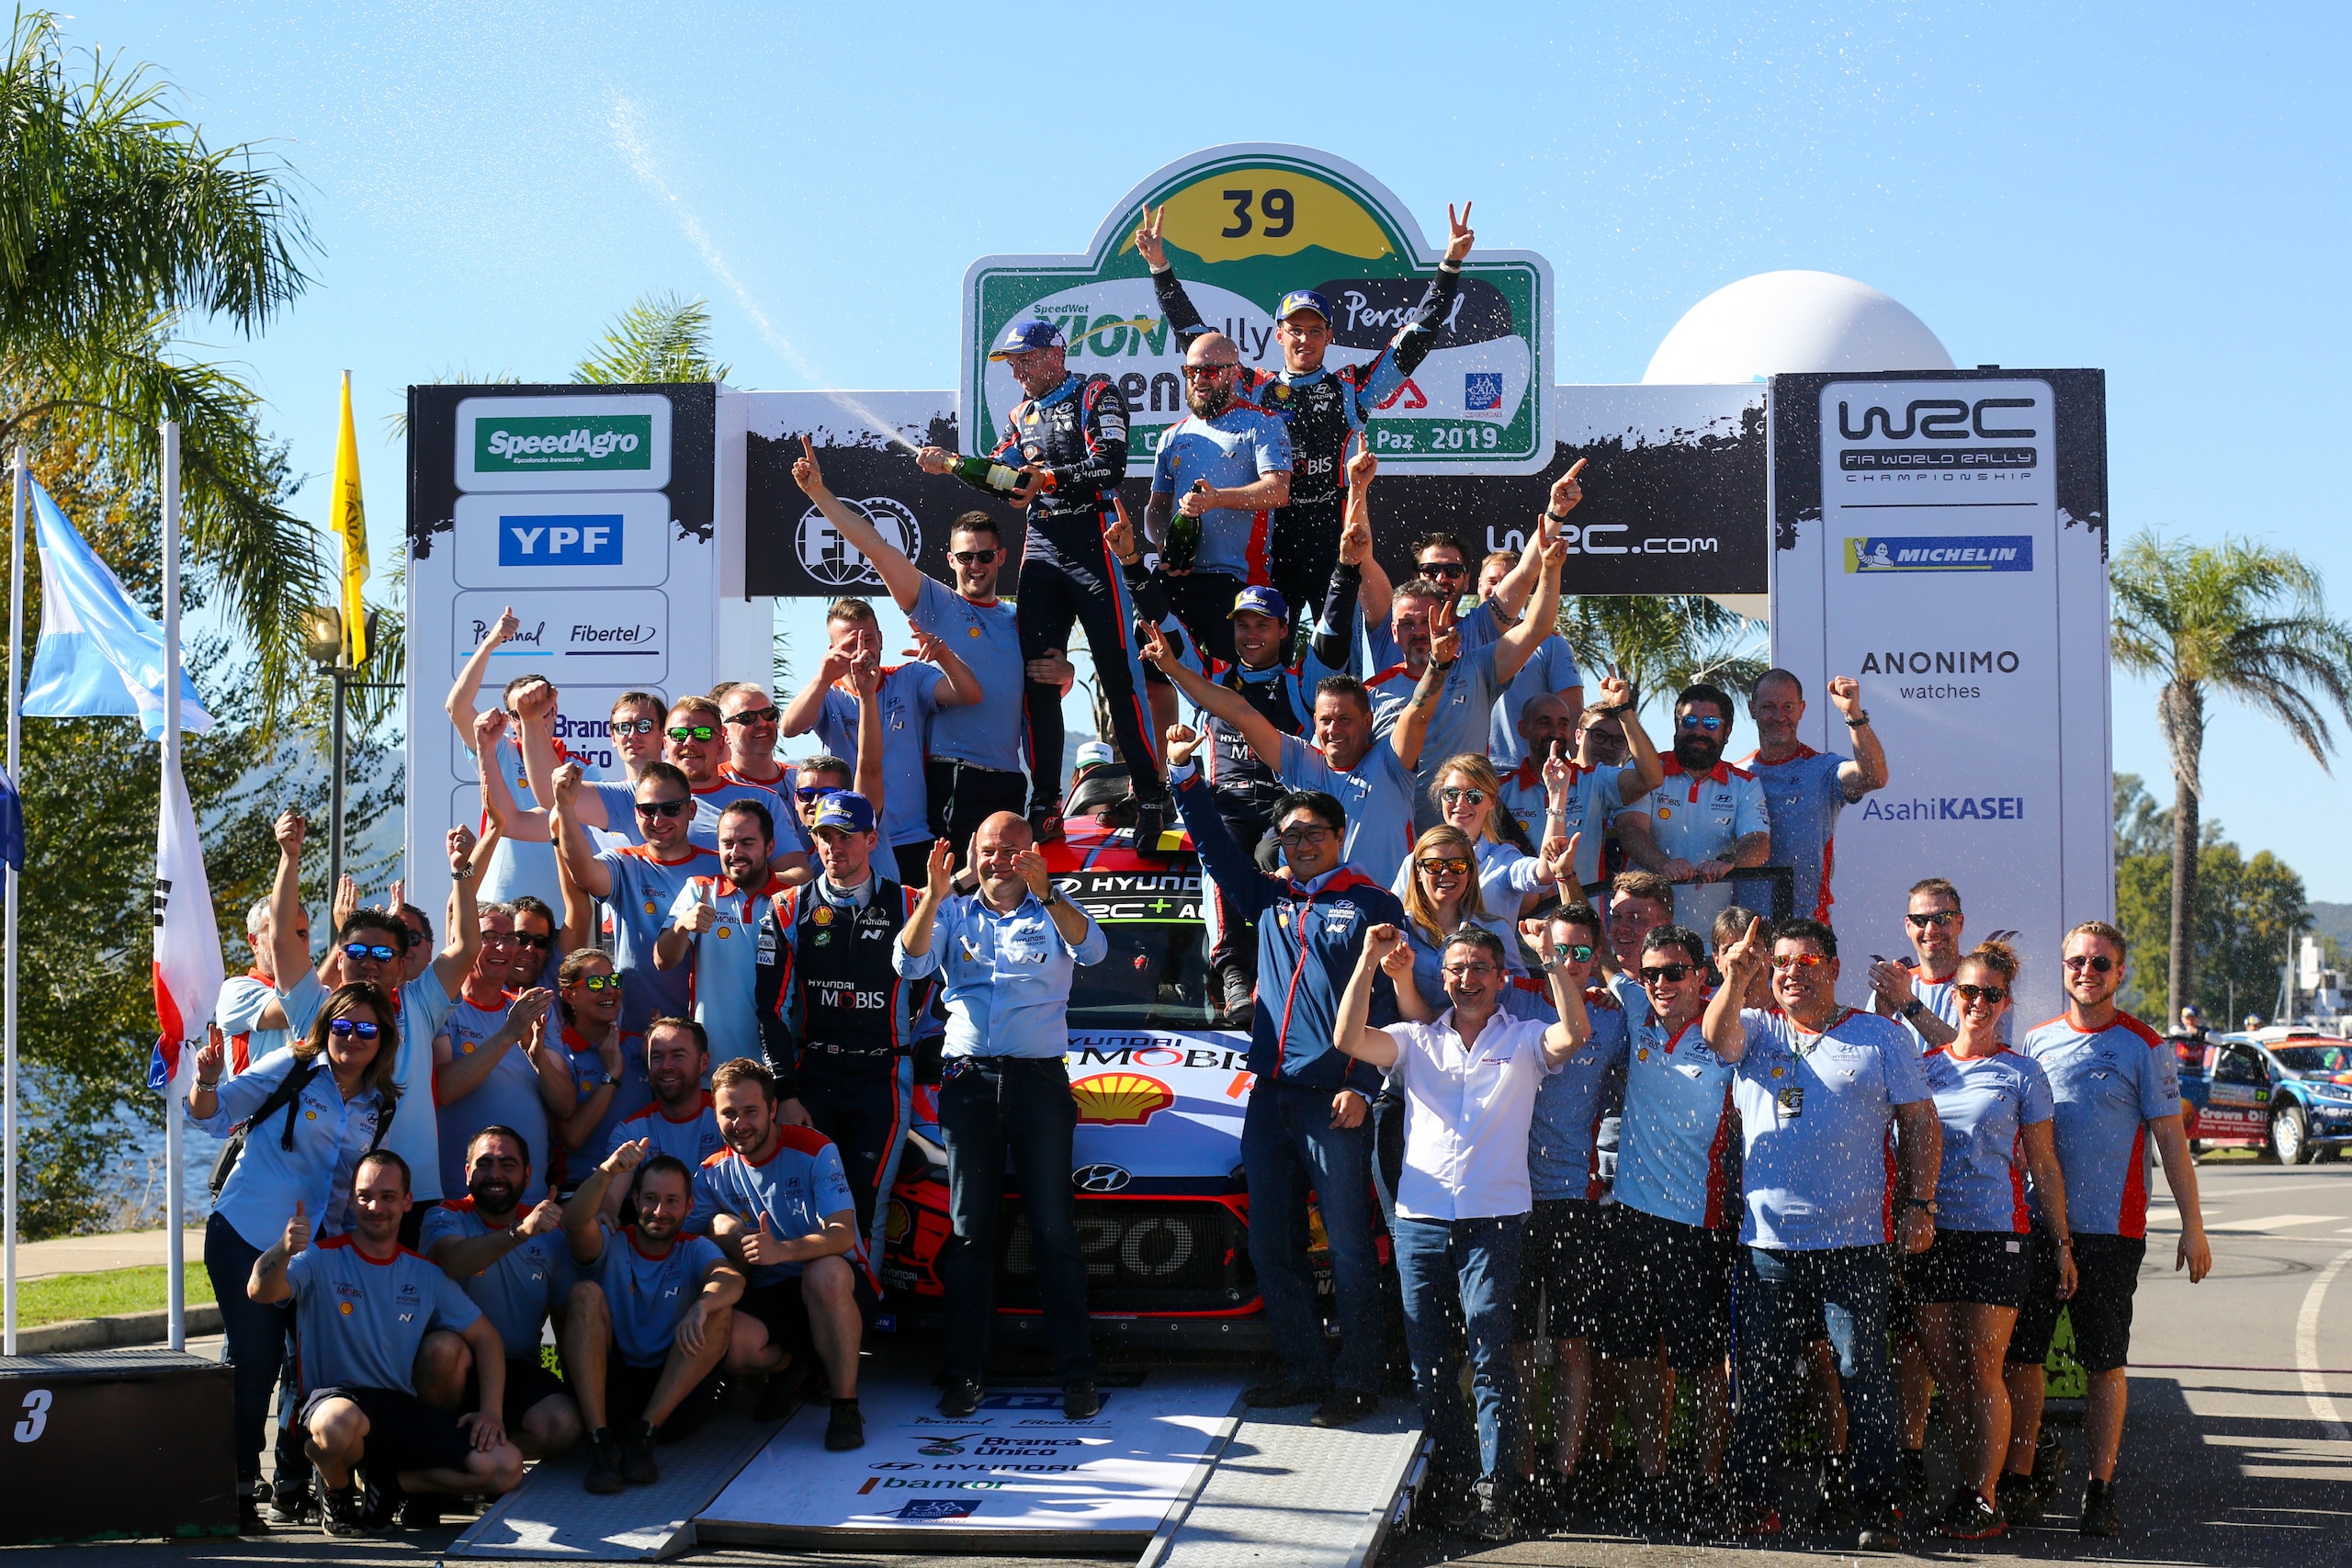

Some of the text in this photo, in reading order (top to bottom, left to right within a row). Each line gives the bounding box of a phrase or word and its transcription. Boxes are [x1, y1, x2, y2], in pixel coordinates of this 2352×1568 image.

[1221, 189, 1295, 238] 39
[1034, 304, 1090, 313] SpeedWet
[1343, 290, 1465, 333] Persol
[1838, 398, 2037, 441] WRC
[488, 429, 639, 458] SpeedAgro
[1377, 428, 1498, 449] Paz 2019
[1293, 457, 1333, 476] OBIS
[1846, 453, 2032, 465] FIA WORLD RALLY
[1847, 472, 2032, 482] CHAMPIONSHIP
[511, 527, 611, 554] YPF
[1896, 547, 2018, 563] MICHELIN
[571, 626, 641, 643] Fibertel
[1860, 650, 2020, 675] ANONIMO
[1900, 683, 1981, 699] watches
[554, 715, 613, 738] Branc
[1220, 734, 1246, 743] HYUN
[1657, 796, 1681, 807] MOBIS
[1862, 797, 2023, 820] AsahiKASEI
[1091, 876, 1204, 892] HYUND
[641, 888, 666, 898] MOBIS
[714, 915, 741, 924] MOBIS
[808, 979, 854, 990] HYUNDAI
[821, 989, 886, 1009] MOBIS
[456, 1029, 483, 1040] MOBIS
[1067, 1037, 1182, 1047] YUNDAI
[1079, 1047, 1250, 1070] MOBIS
[2200, 1107, 2243, 1121] Crown
[883, 1277, 909, 1290] STEEL
[336, 1287, 362, 1299] MOBS
[14, 1389, 53, 1443] 3
[914, 1416, 995, 1426] Personal
[981, 1437, 1084, 1446] Branca
[883, 1477, 1013, 1489] bancor
